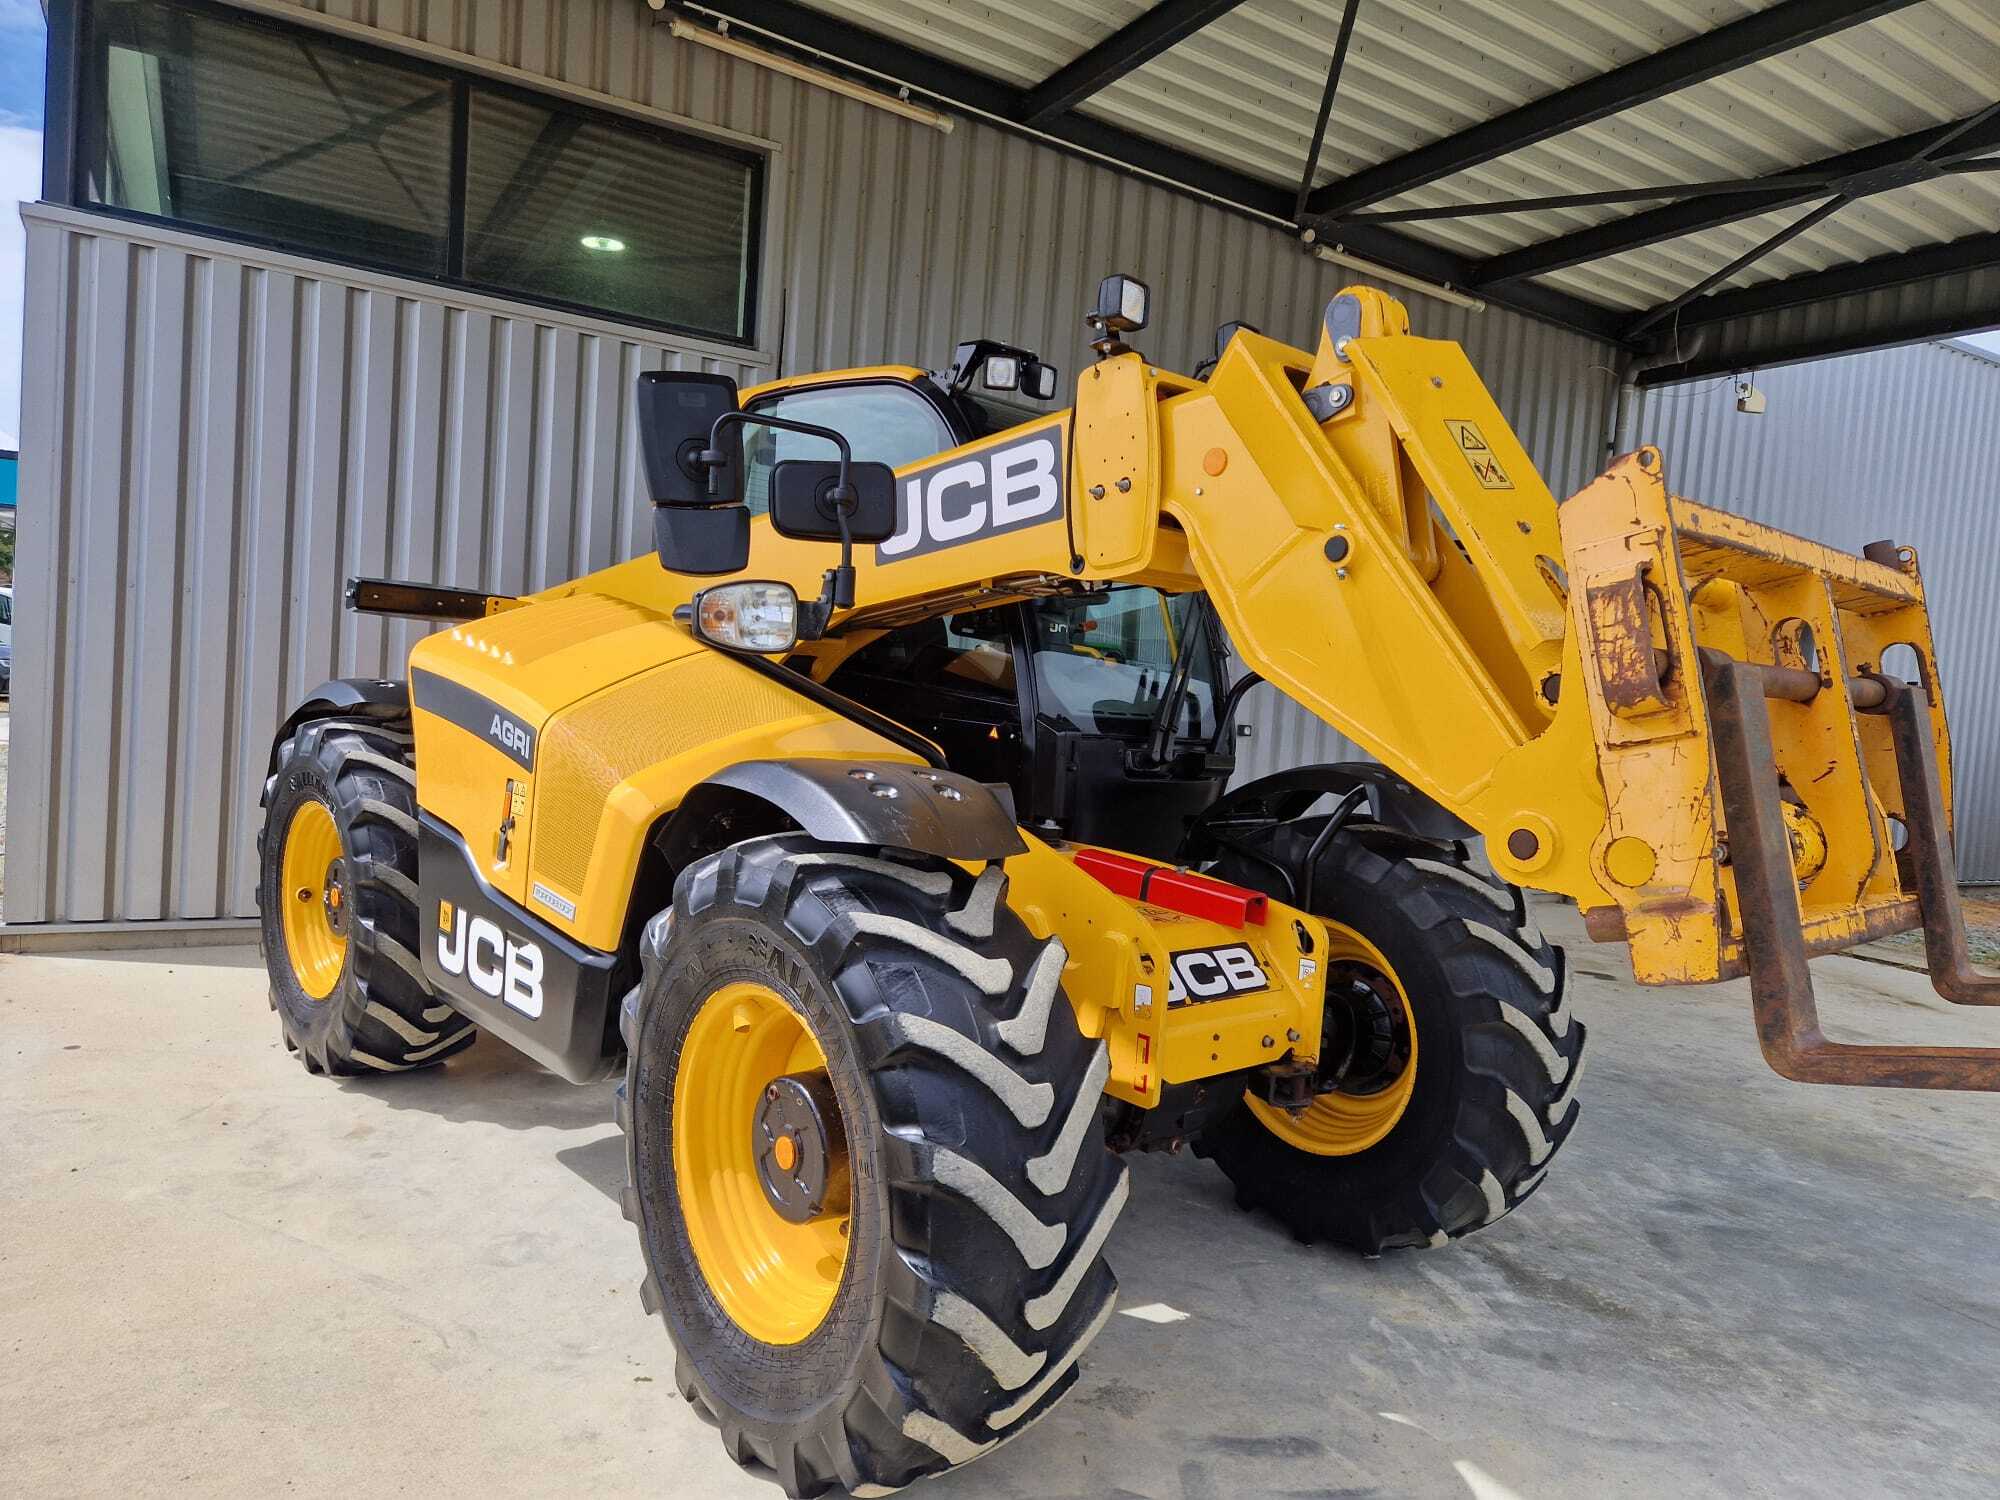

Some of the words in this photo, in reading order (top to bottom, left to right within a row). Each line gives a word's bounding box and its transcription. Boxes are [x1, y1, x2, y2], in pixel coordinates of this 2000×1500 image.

[880, 439, 1058, 555] JCB
[489, 713, 531, 759] AGRI
[437, 904, 544, 1019] JCB
